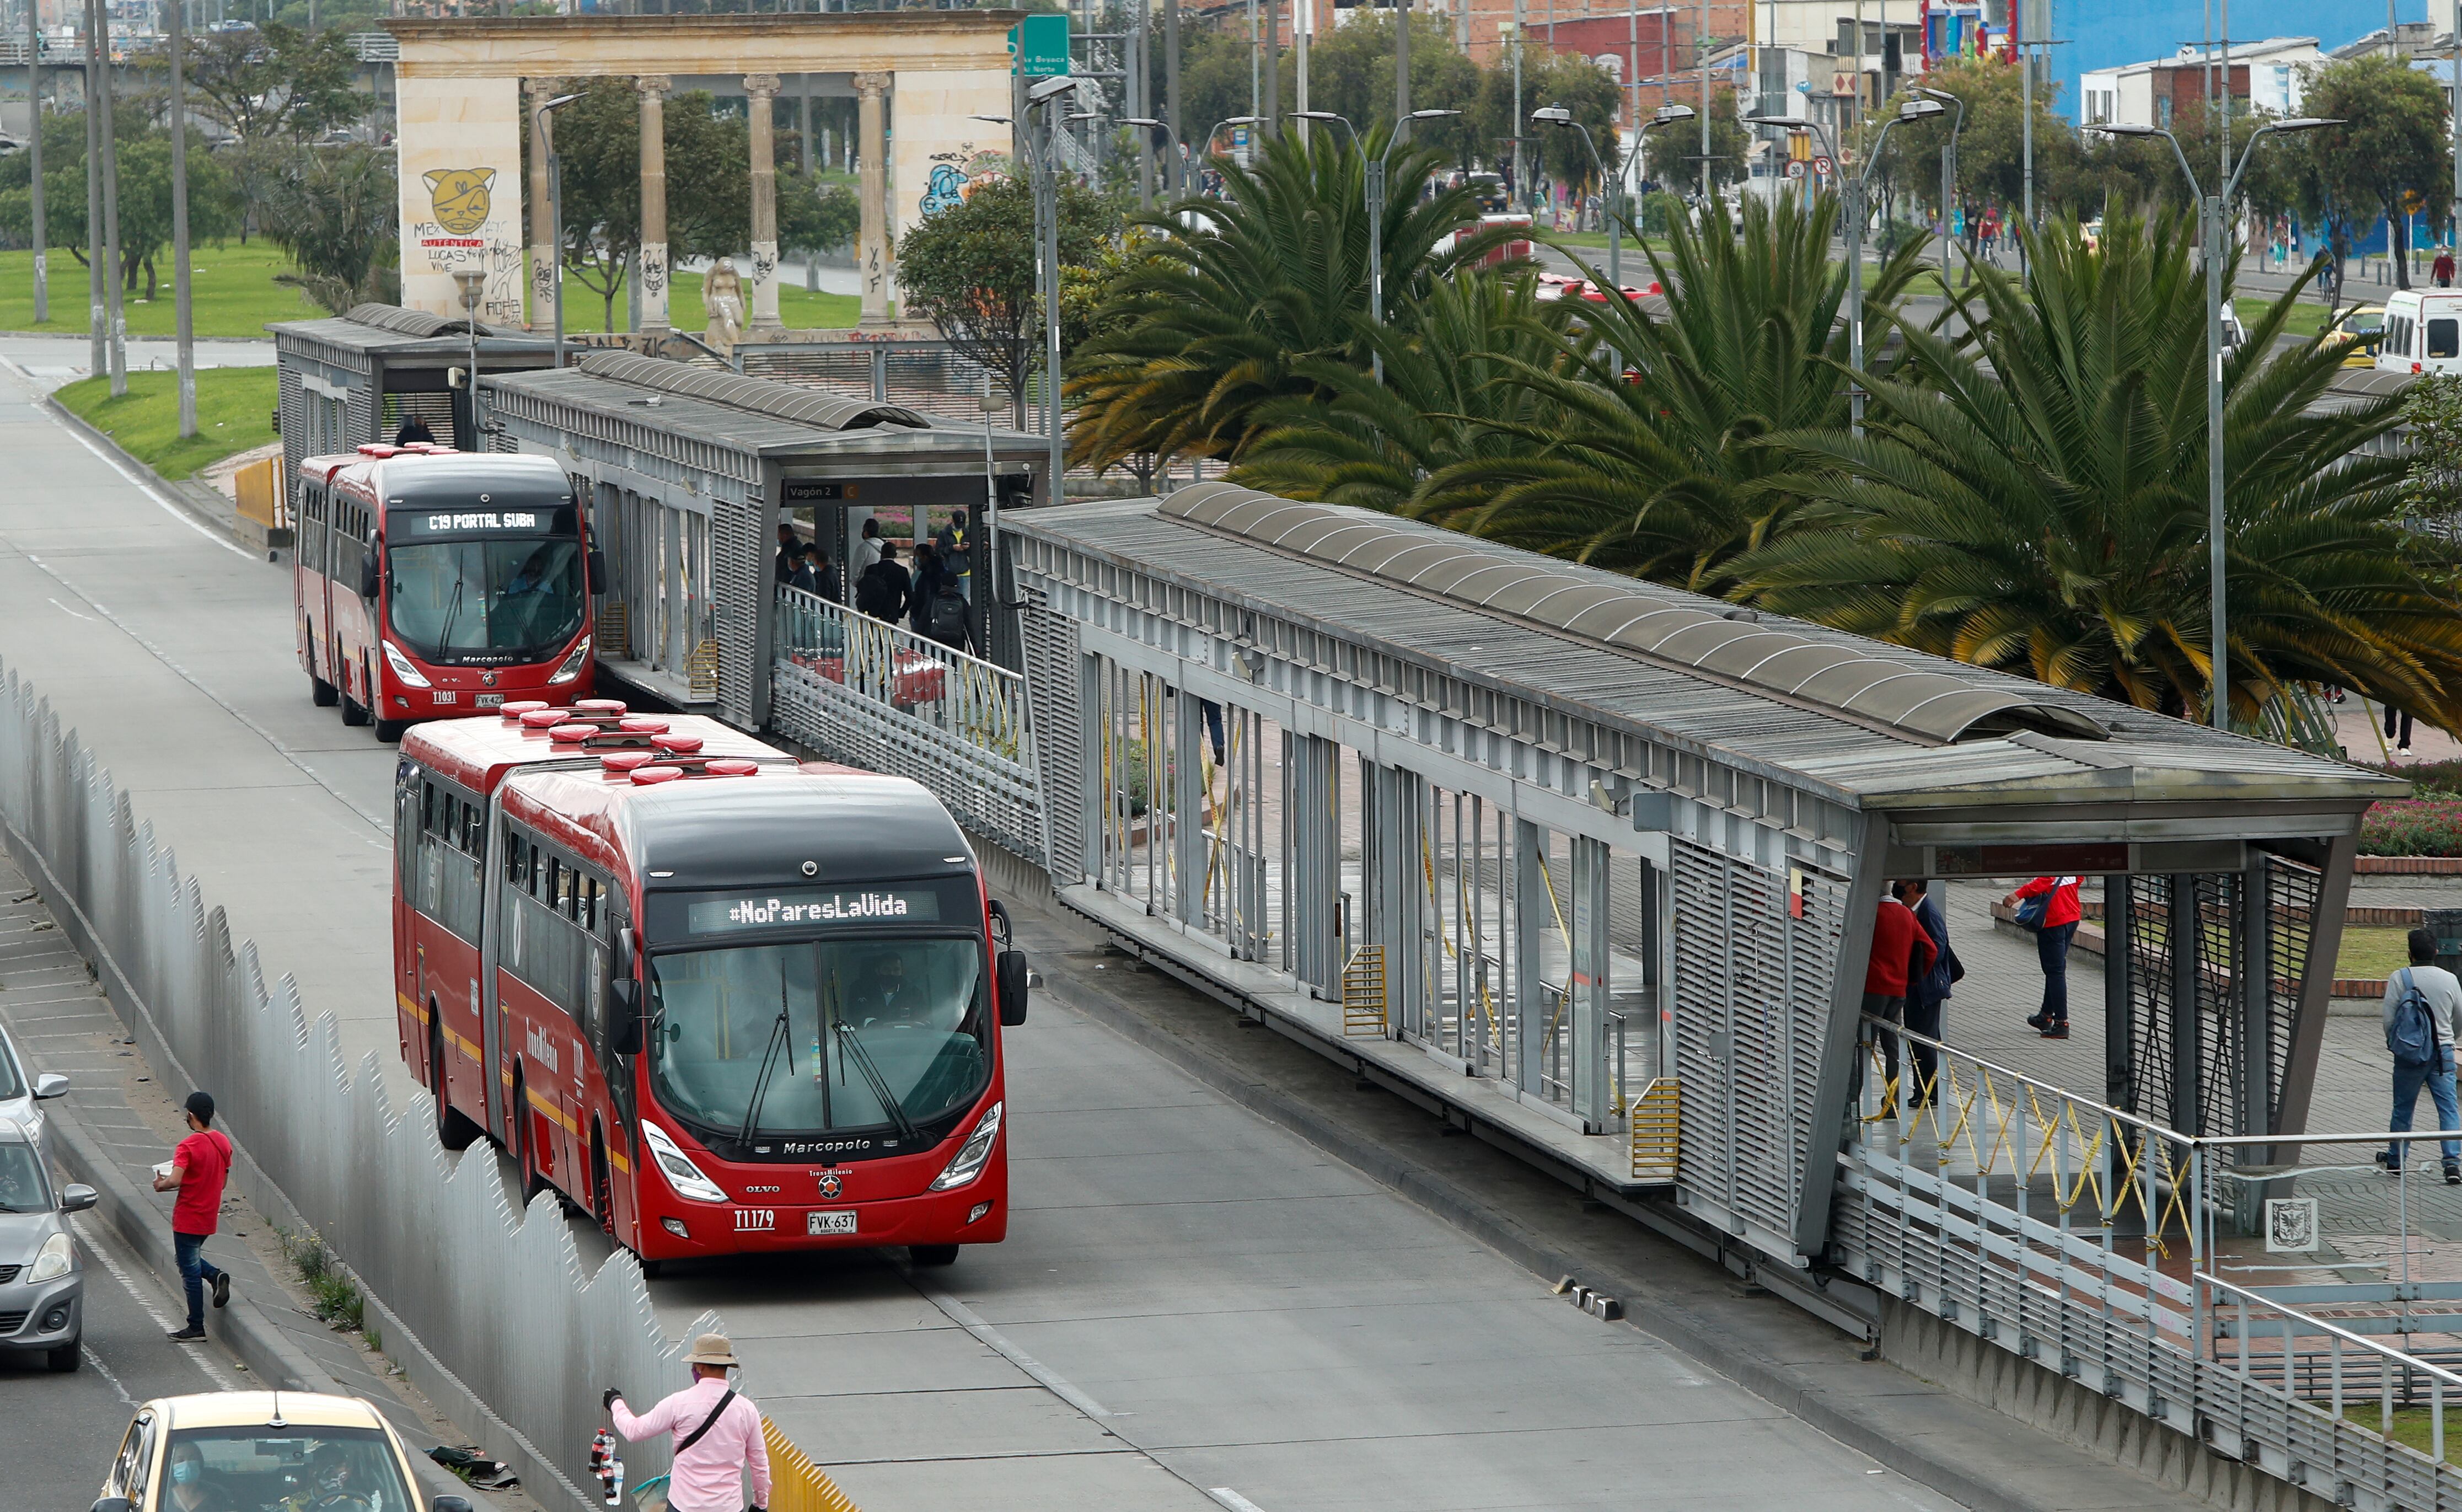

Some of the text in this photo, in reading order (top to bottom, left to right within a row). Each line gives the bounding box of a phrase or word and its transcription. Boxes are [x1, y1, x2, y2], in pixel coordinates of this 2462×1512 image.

[1791, 166, 1800, 174] 30
[428, 250, 466, 262] LUCAS
[790, 487, 831, 498] Vagón 2
[847, 486, 854, 496] C
[429, 513, 535, 529] C19 PORTAL SUBA
[432, 691, 457, 702] T1031
[730, 893, 907, 924] #NoParesLaVida
[783, 1139, 871, 1154] Marcopolo
[734, 1210, 774, 1227] T1179
